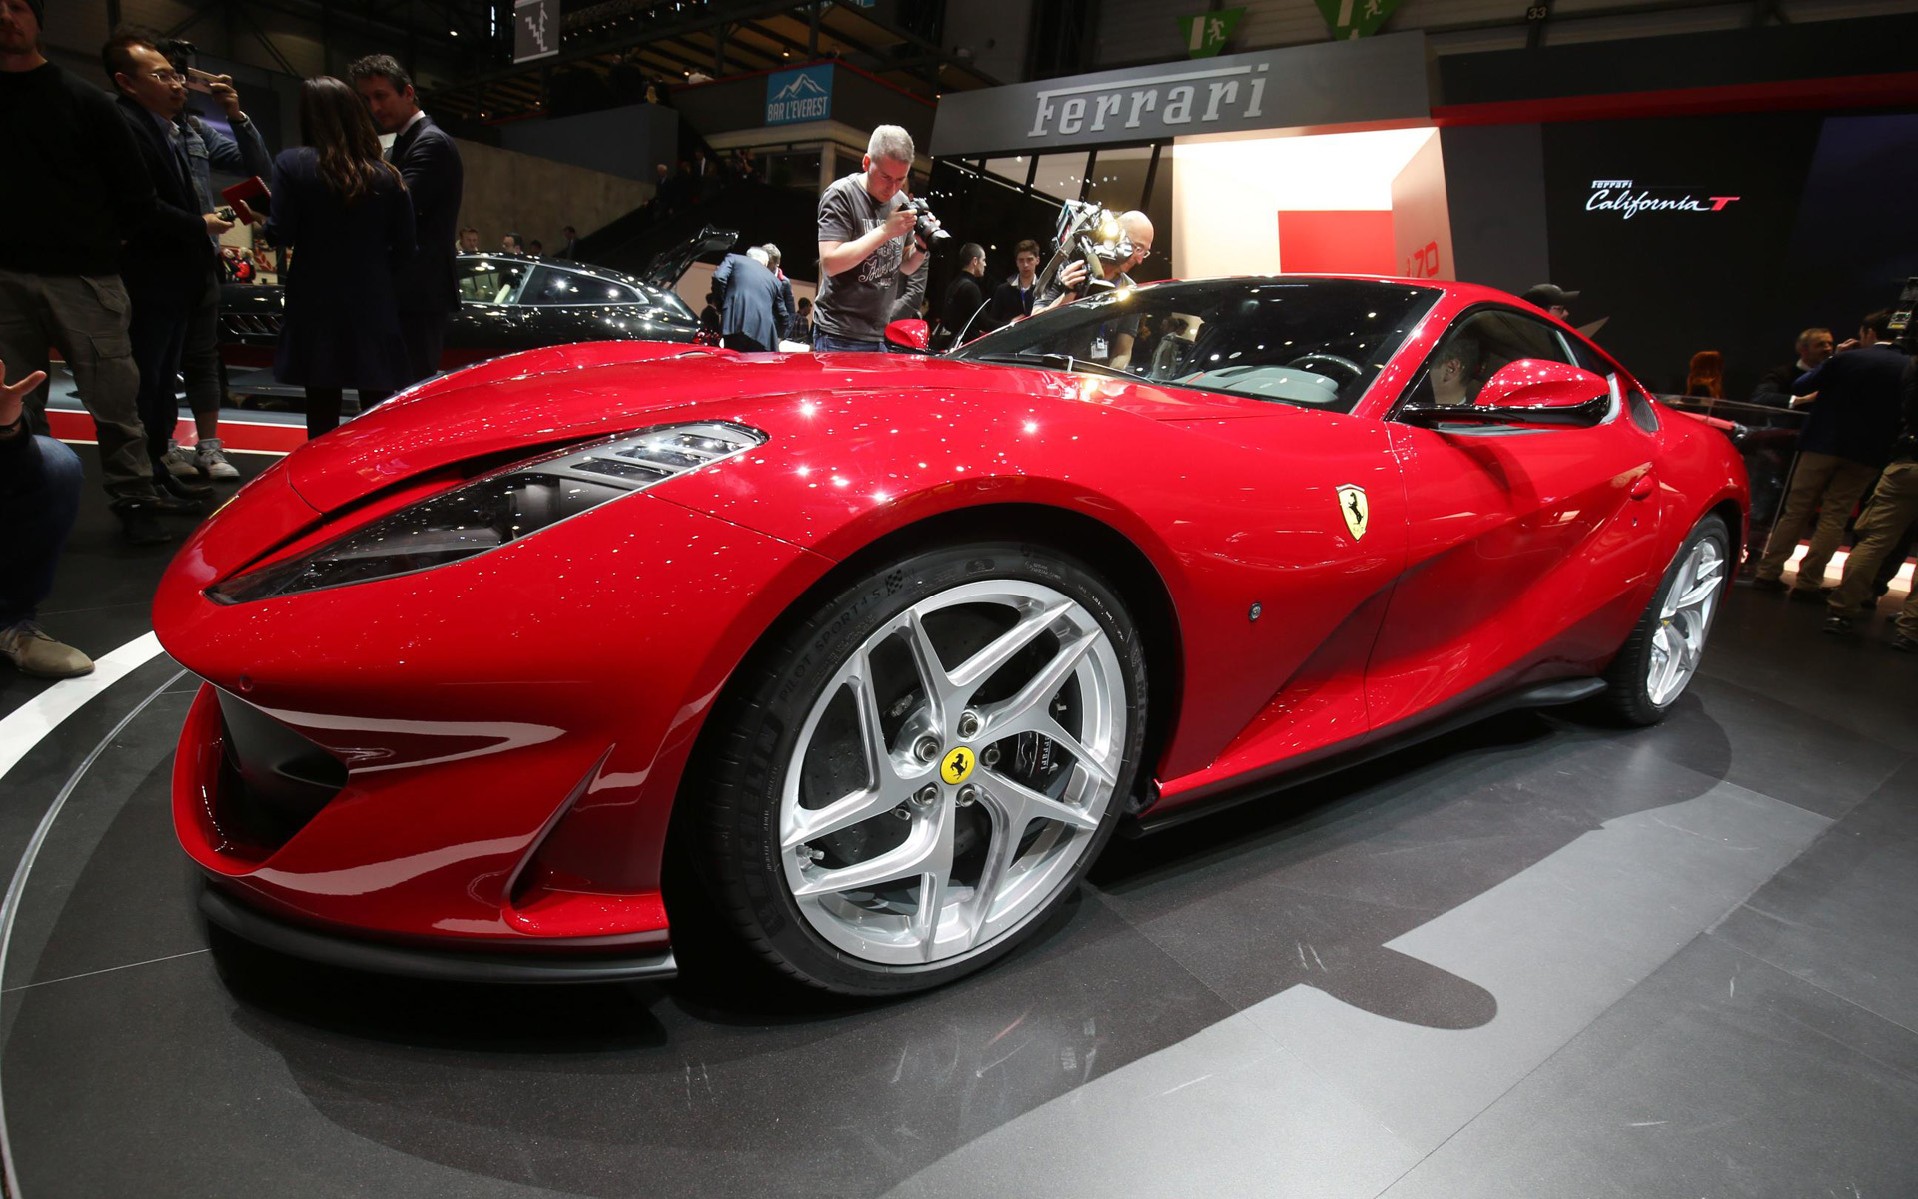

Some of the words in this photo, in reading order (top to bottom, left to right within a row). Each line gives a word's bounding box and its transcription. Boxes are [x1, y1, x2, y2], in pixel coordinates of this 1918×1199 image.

[767, 102, 784, 122] BAR
[786, 96, 828, 120] L'EVEREST
[1028, 63, 1269, 137] Ferrari
[1591, 180, 1633, 189] Ferrari
[1585, 189, 1711, 220] California
[1708, 196, 1740, 211] T
[778, 653, 813, 702] PILOT
[814, 602, 861, 650] SPORT
[1040, 736, 1052, 772] errari
